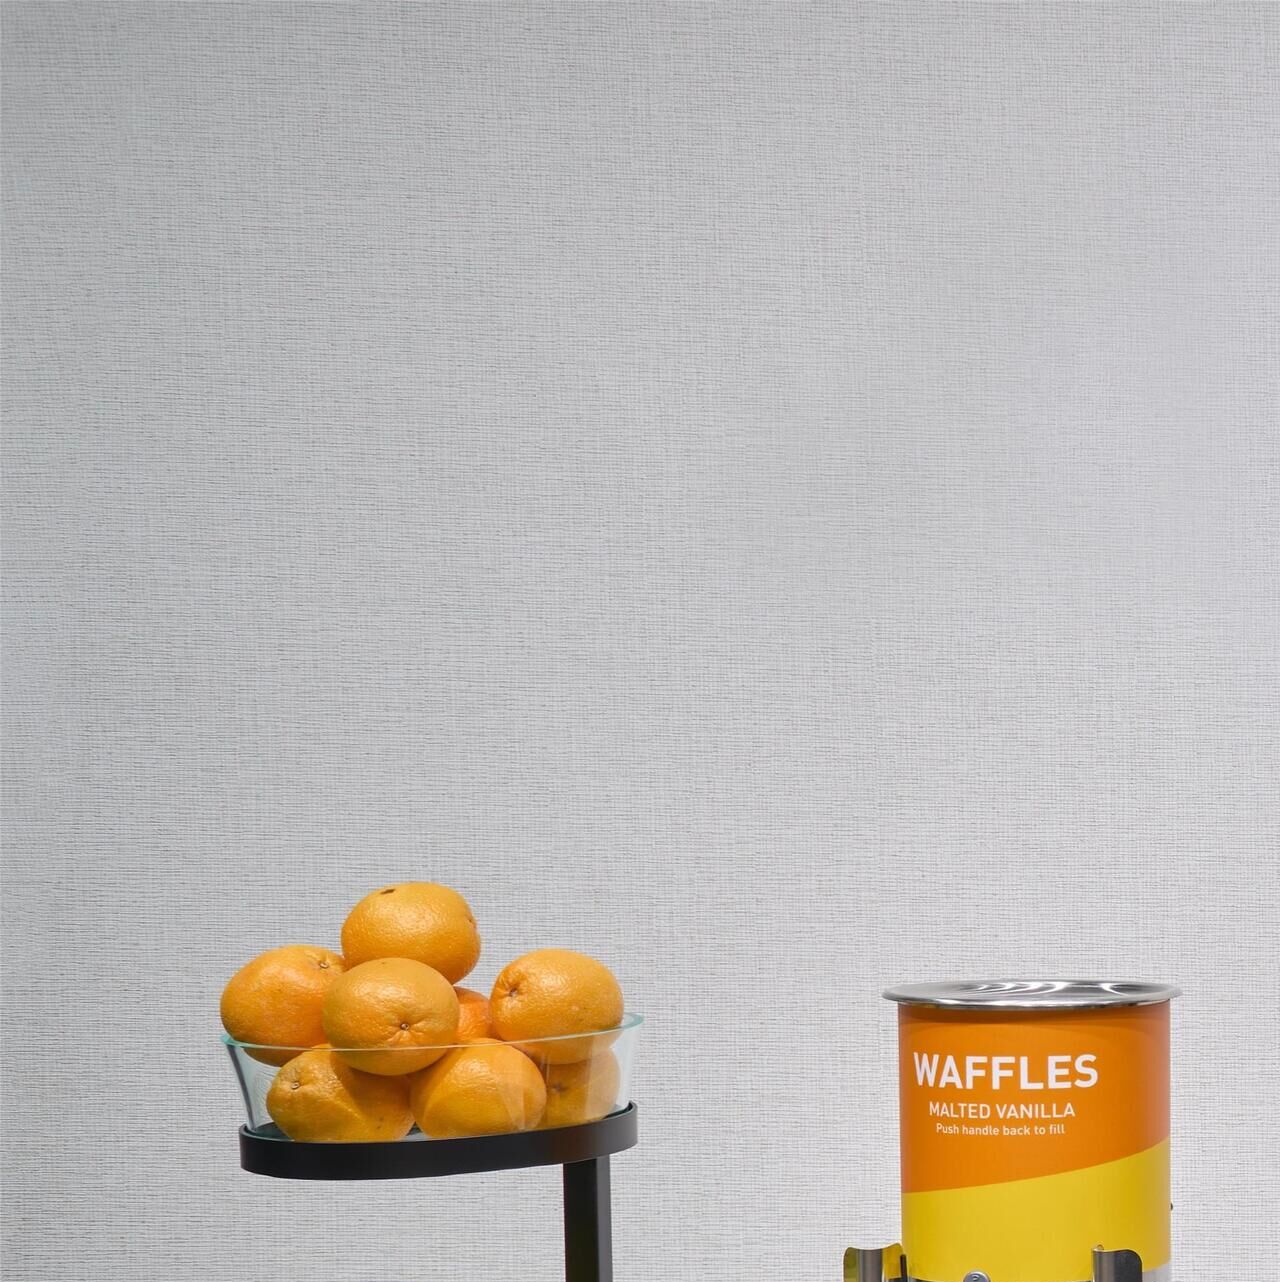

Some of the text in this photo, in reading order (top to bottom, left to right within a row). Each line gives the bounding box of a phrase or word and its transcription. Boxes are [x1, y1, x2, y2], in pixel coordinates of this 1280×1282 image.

[913, 1052, 1098, 1090] WAFFLES
[929, 1101, 1076, 1119] MALTED VANILLA
[936, 1123, 1065, 1135] Push handle back to fill
